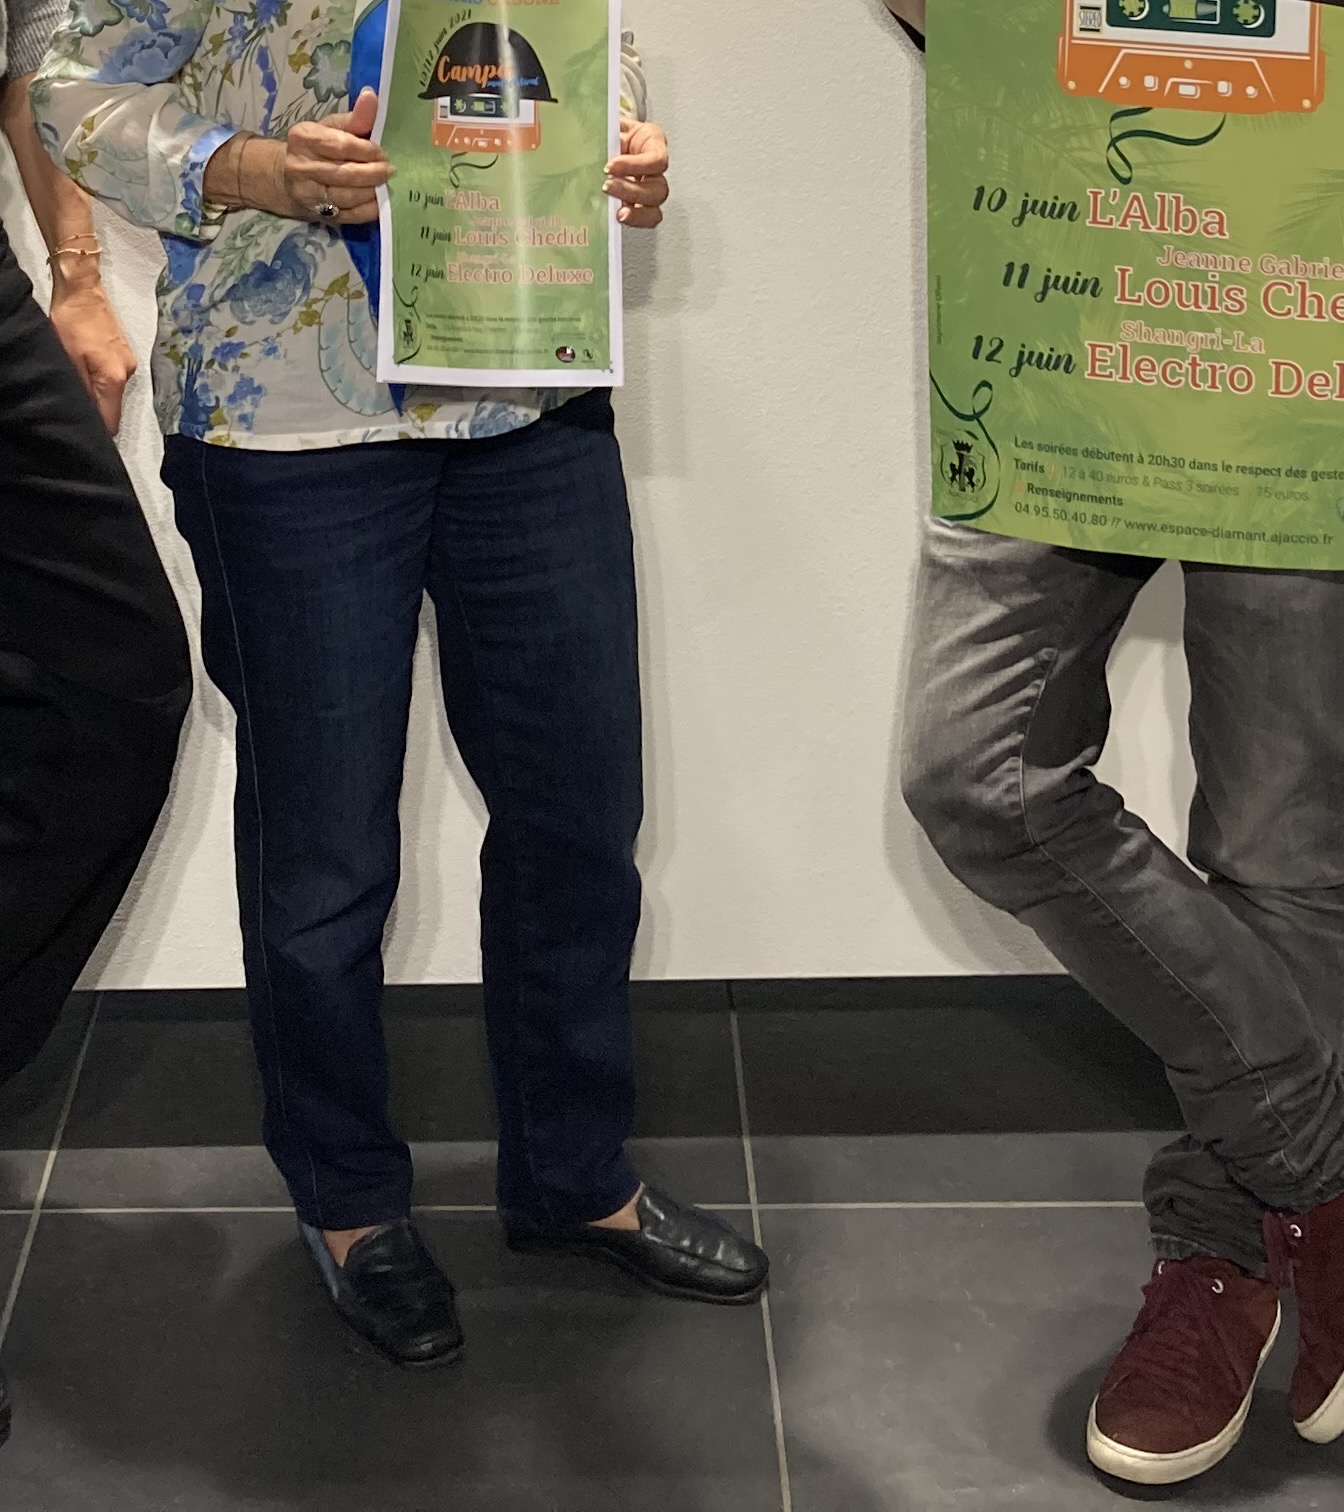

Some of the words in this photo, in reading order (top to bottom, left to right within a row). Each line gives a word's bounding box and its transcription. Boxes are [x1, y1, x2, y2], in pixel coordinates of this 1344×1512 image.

[971, 185, 1007, 213] 10
[1011, 192, 1080, 228] juin
[446, 262, 513, 284] Electro
[1157, 245, 1253, 273] Jeanne
[1001, 260, 1030, 289] 11
[1034, 268, 1104, 303] juin
[1114, 265, 1247, 315] Louis
[1120, 320, 1266, 355] Shangri-La
[971, 334, 1005, 364] 12
[1008, 343, 1077, 378] juin
[1085, 341, 1256, 394] Electro
[1013, 457, 1045, 473] Tarifs
[1014, 435, 1034, 449] Les
[1148, 454, 1186, 469] 20h30
[1188, 458, 1218, 472] dans
[1221, 460, 1233, 473] le
[1236, 463, 1281, 478] respect
[1285, 466, 1307, 479] des
[1026, 482, 1124, 507] Renseignements
